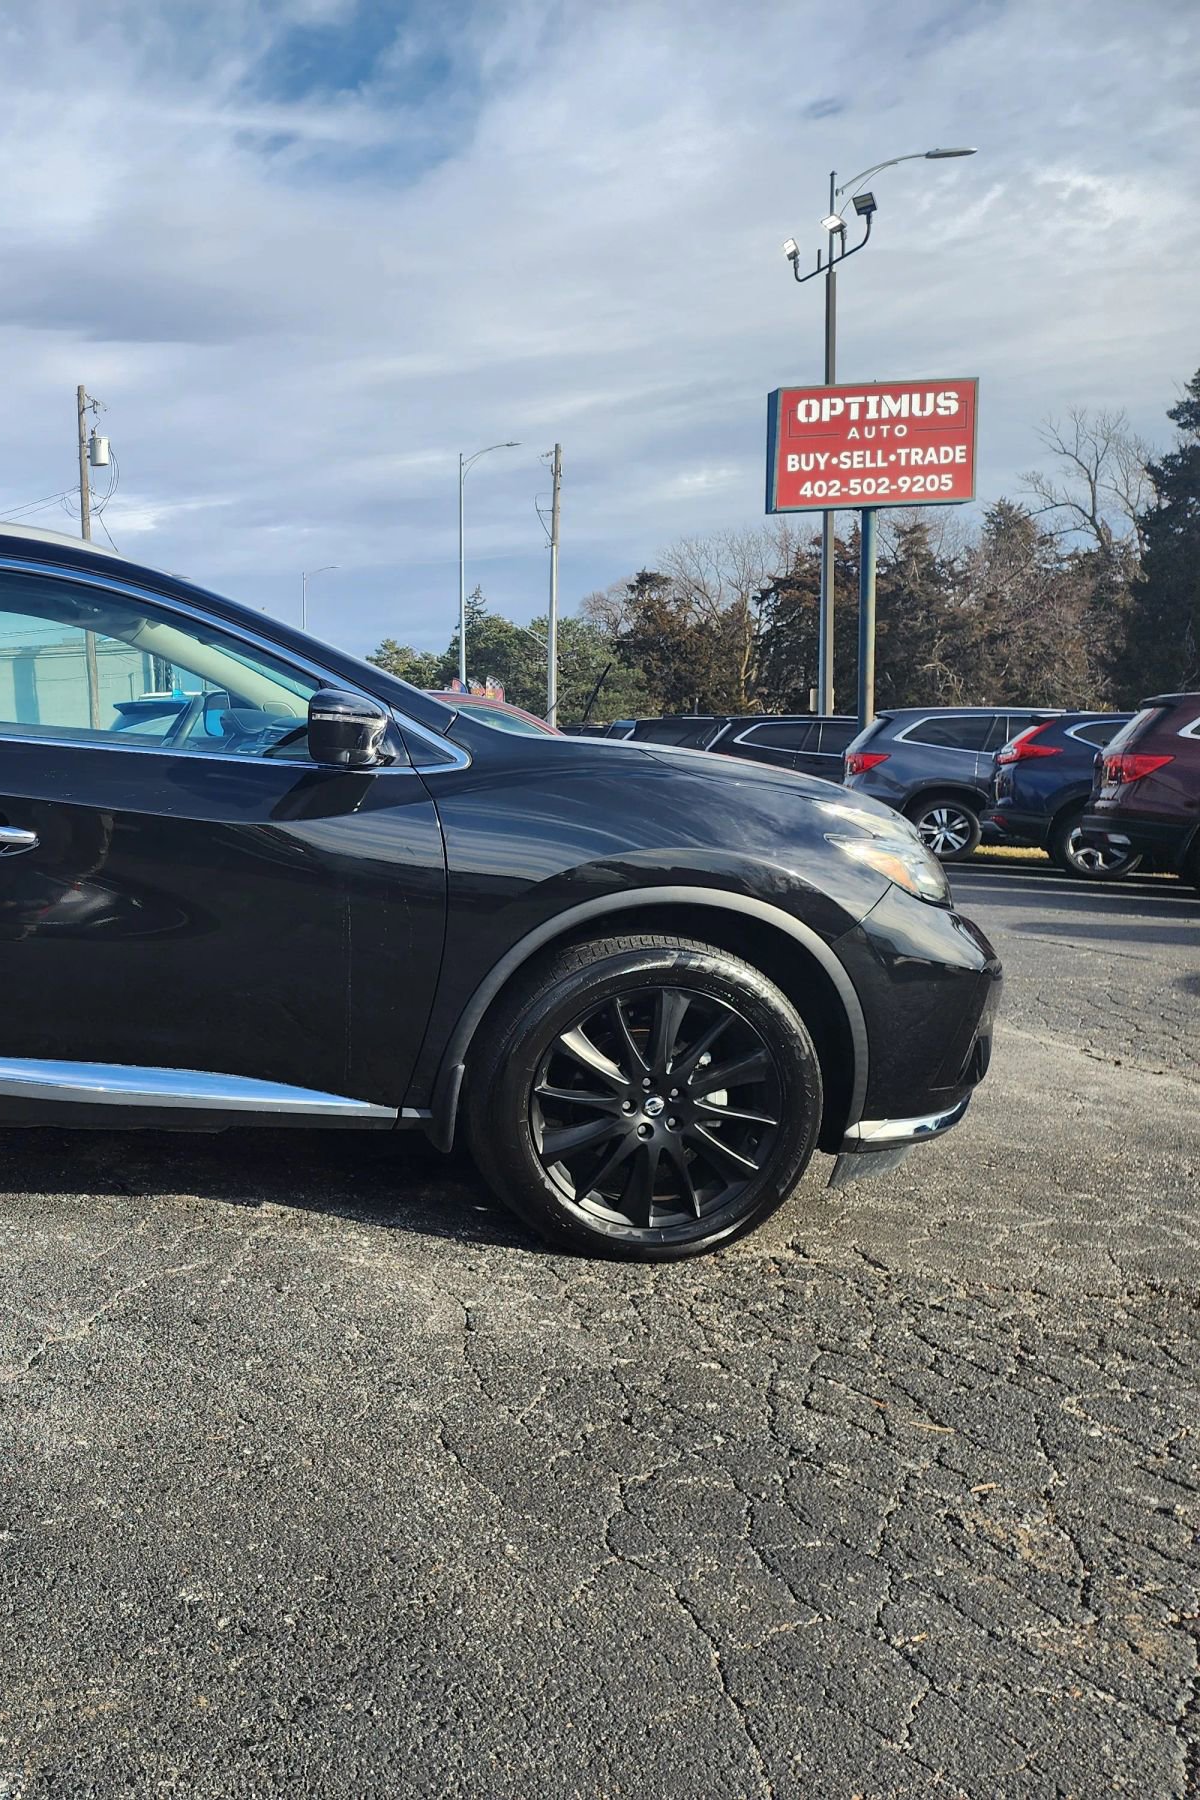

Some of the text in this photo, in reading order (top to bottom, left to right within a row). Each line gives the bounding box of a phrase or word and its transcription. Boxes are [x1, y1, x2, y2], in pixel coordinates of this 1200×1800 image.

[797, 391, 959, 423] OPTIMUS
[847, 424, 908, 440] AUTO
[799, 474, 953, 498] 402-502-9205
